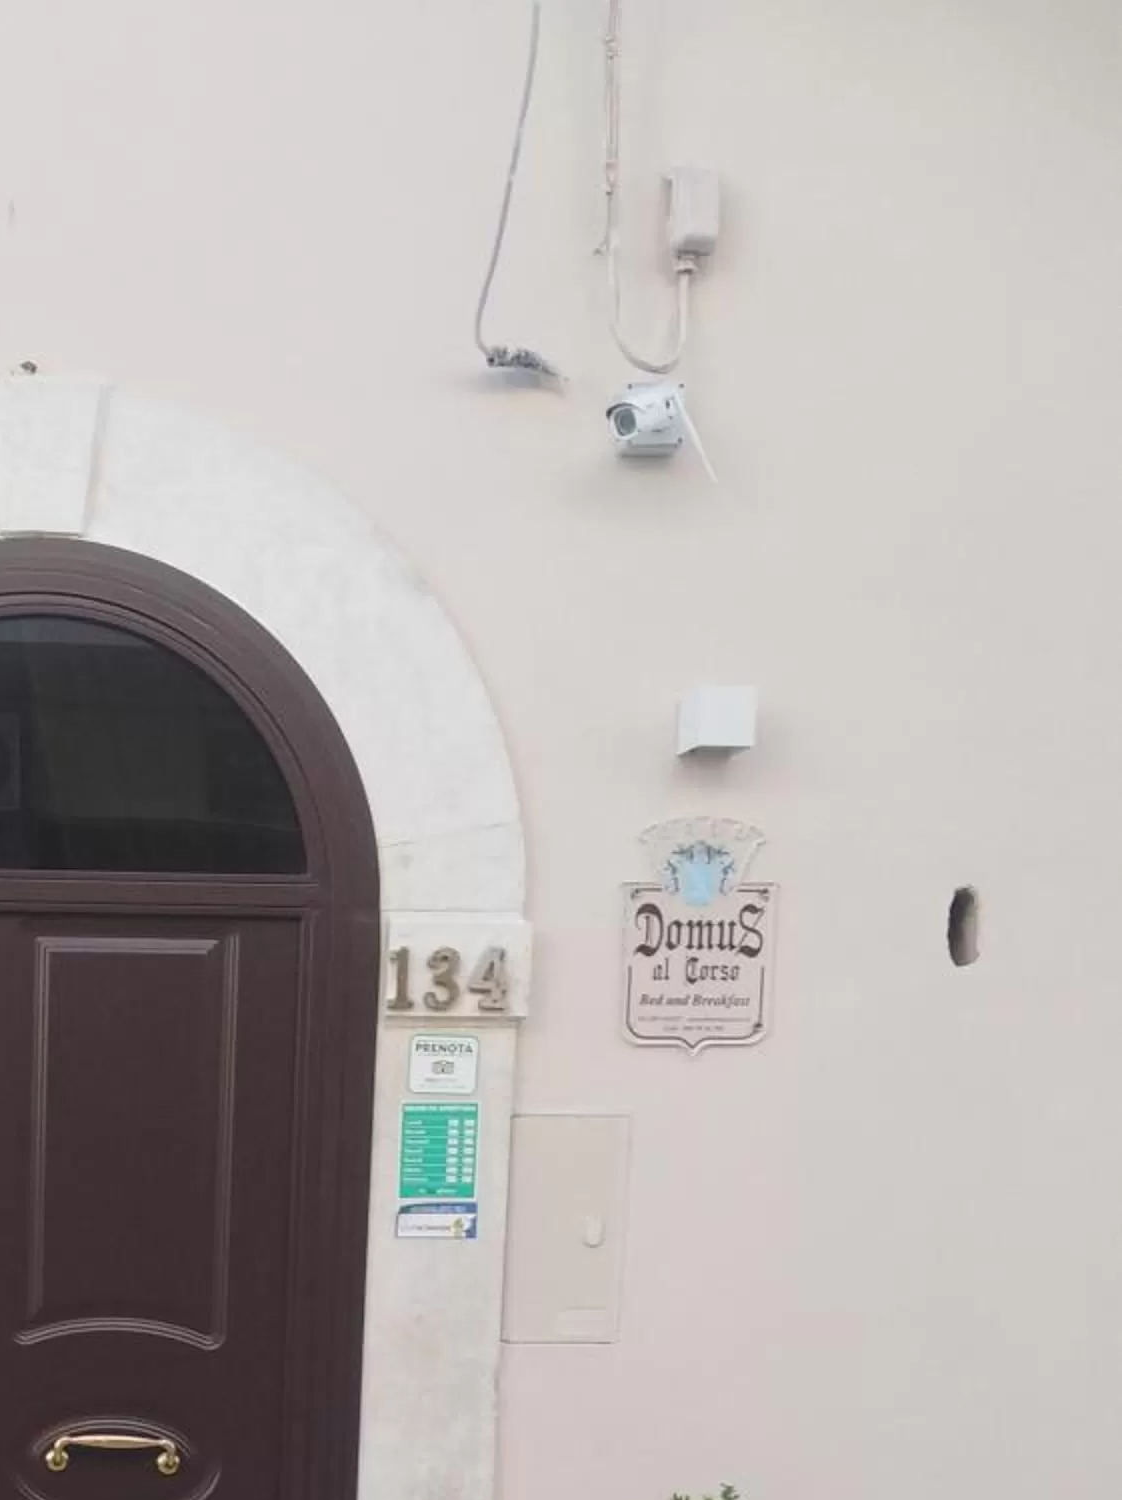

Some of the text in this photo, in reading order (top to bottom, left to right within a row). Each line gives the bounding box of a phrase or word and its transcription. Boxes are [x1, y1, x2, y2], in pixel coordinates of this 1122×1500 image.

[385, 946, 508, 1010] 134
[653, 956, 740, 984] al Corso
[640, 993, 751, 1009] Bed and Breakfast
[415, 1043, 473, 1053] PRENOTA
